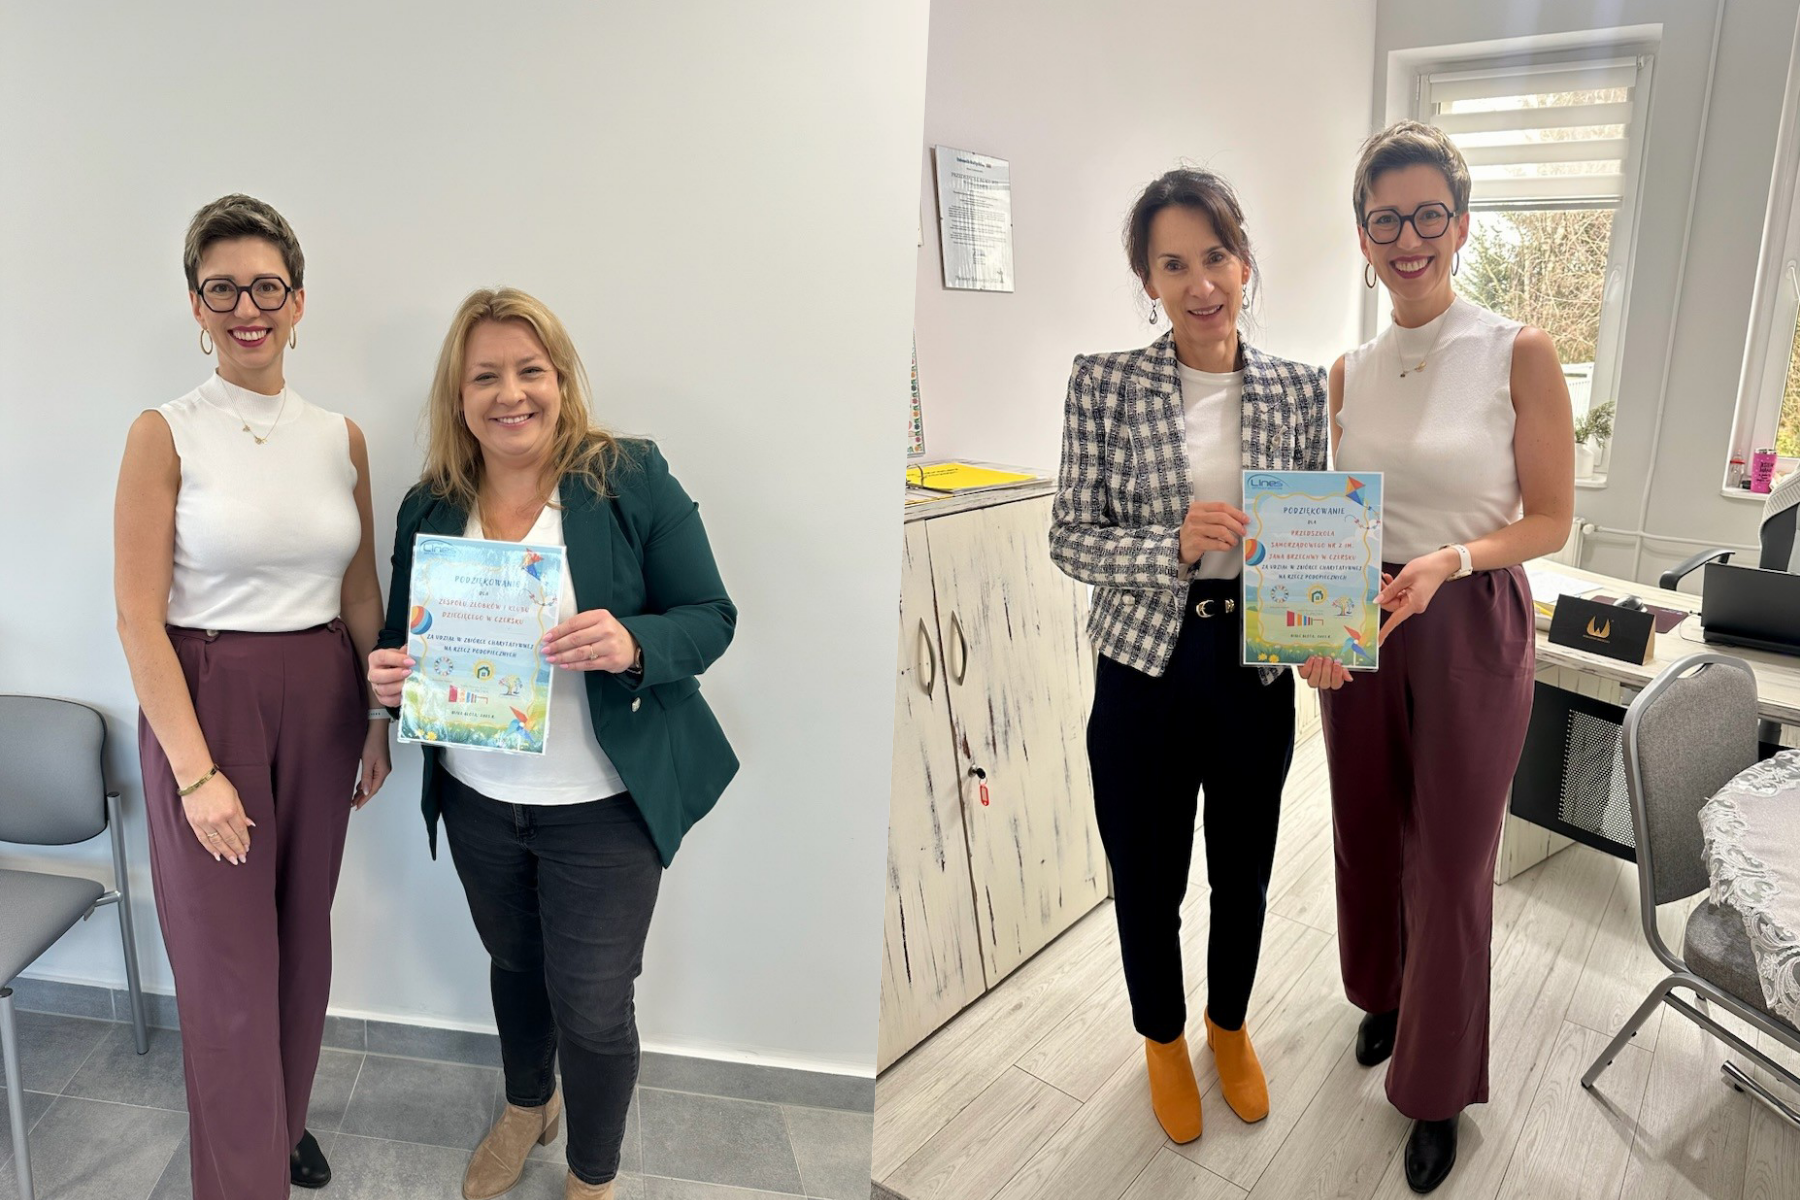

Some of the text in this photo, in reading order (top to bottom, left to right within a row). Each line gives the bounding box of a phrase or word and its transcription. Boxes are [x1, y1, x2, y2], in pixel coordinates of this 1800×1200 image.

[1251, 479, 1283, 487] Lines
[1283, 507, 1345, 515] PODZIĘKOWANIE
[1271, 542, 1325, 550] SAMORZĄDOWEGO
[454, 575, 520, 588] PODZIĘKOWANIE
[442, 611, 483, 621] DZIECIĘCEGO
[494, 616, 524, 625] CZERSKU
[488, 640, 534, 650] CHARYTATYWNEJ
[472, 648, 517, 657] PODOPIECZNYCH
